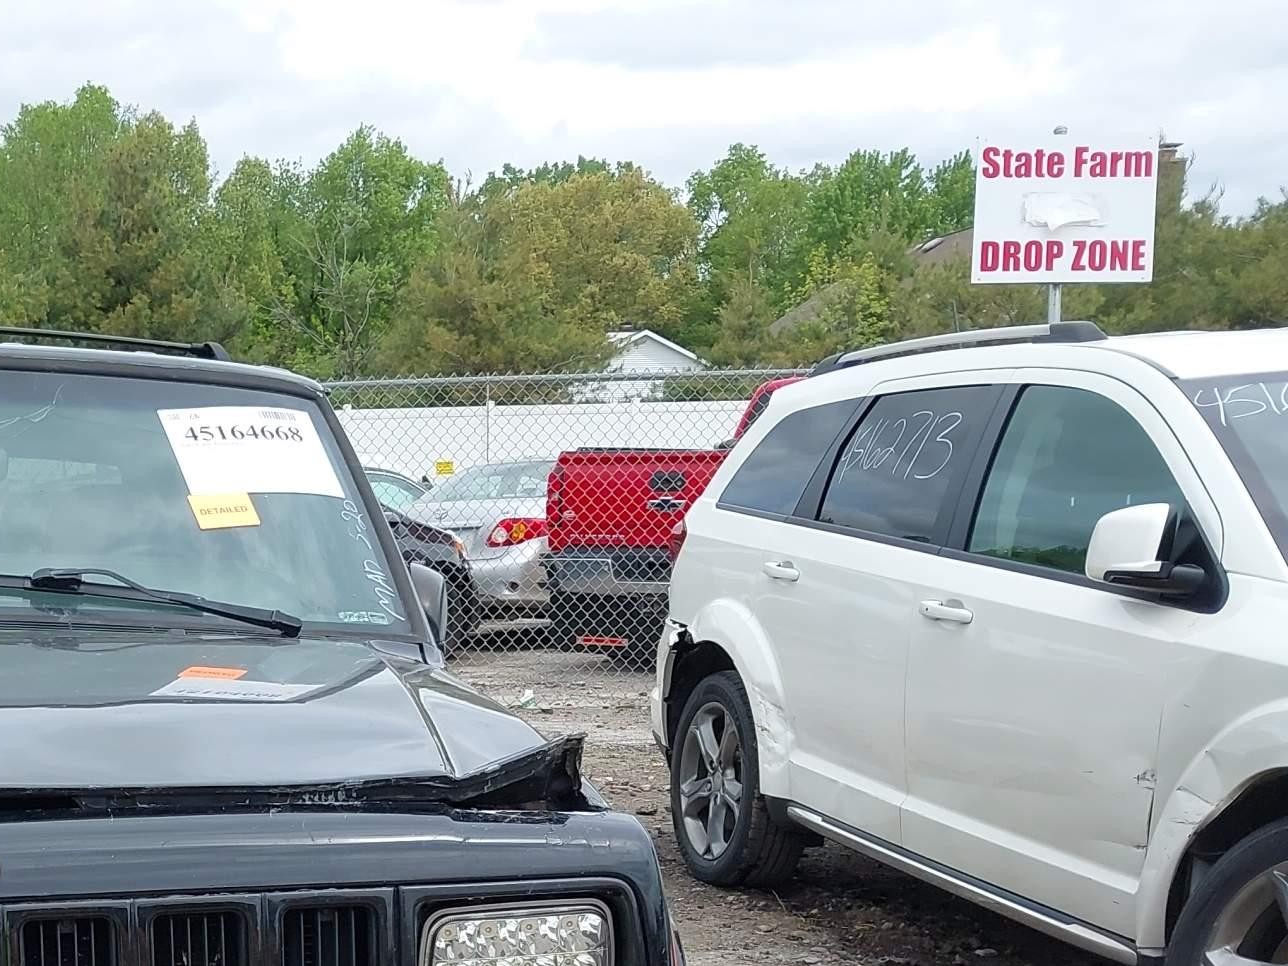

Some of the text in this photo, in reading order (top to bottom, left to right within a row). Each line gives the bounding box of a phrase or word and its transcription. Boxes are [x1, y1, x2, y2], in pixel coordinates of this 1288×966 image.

[982, 146, 1153, 179] State Farm
[980, 240, 1147, 272] DROP ZONE
[184, 424, 304, 442] 45164668
[199, 505, 249, 516] DETAILED
